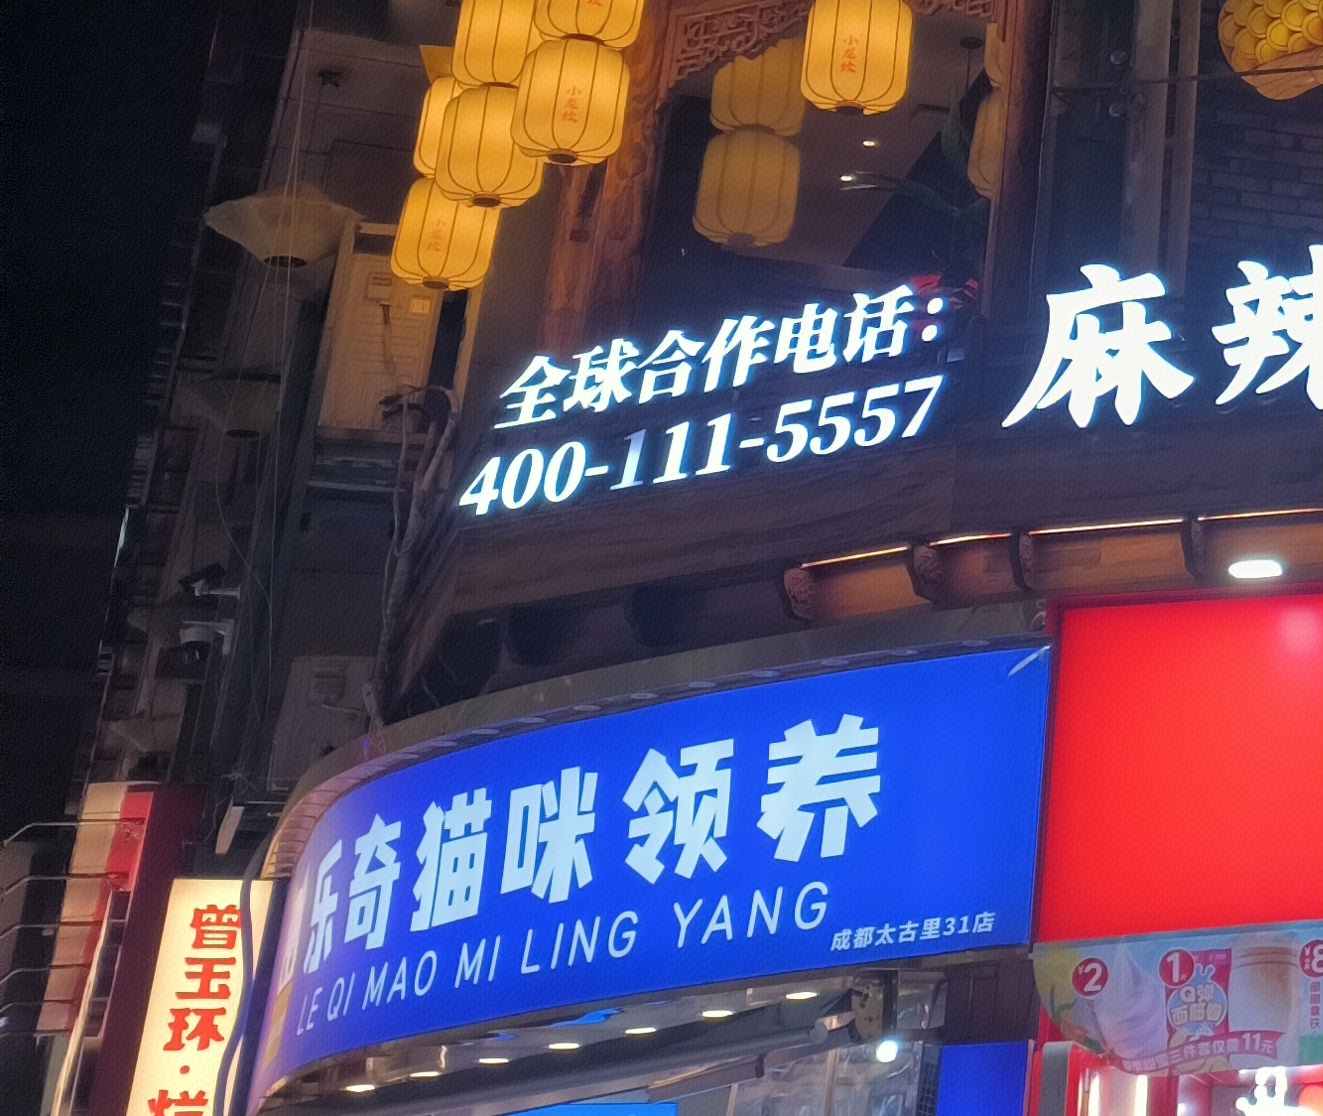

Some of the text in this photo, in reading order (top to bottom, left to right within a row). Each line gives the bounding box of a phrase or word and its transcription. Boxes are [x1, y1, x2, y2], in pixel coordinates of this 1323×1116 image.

[457, 374, 946, 517] 400-111-5557
[296, 879, 833, 1036] LE QI MAO MI LING YANG
[830, 910, 997, 952] 成都太古里31店
